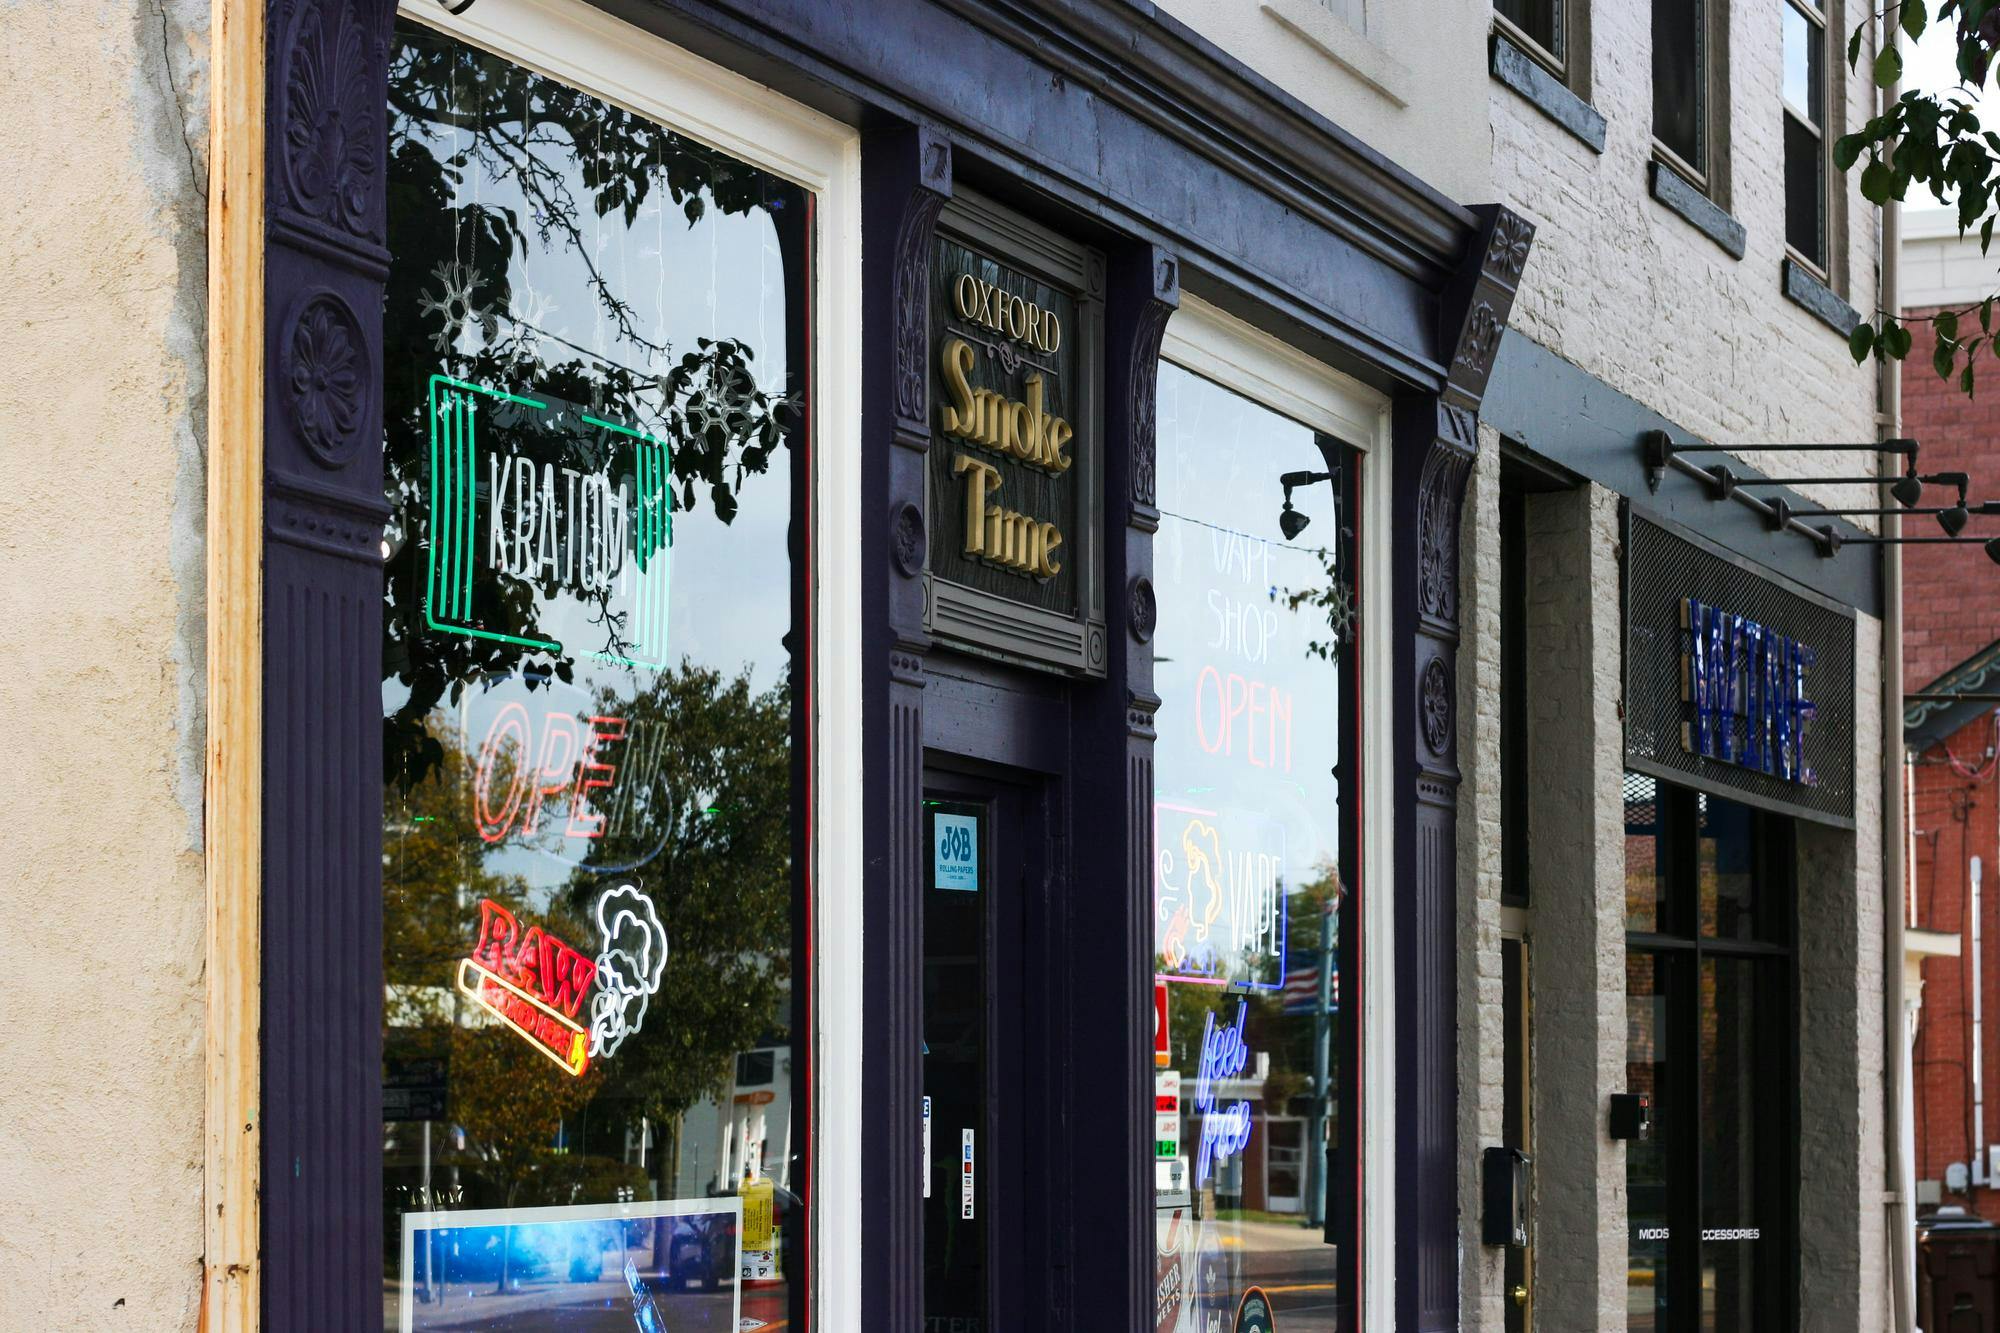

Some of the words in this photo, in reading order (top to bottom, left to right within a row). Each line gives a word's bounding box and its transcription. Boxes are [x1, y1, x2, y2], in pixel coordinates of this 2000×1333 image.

[955, 273, 1061, 353] OXFORD
[943, 338, 1073, 473] Smoke
[488, 451, 628, 597] KRATOM
[953, 454, 1063, 578] Time
[1210, 521, 1277, 589] VAPE
[1207, 588, 1278, 665] SHOP
[1195, 665, 1293, 773] OPEN
[474, 702, 669, 842] OPEN
[941, 826, 971, 861] JOB
[957, 866, 974, 875] PAPERS
[1228, 849, 1281, 957] VAPE
[473, 898, 597, 1018] RAW
[1639, 1228, 1669, 1240] MODS
[1702, 1229, 1760, 1241] CCESSORIES
[1157, 1263, 1181, 1309] ISHER
